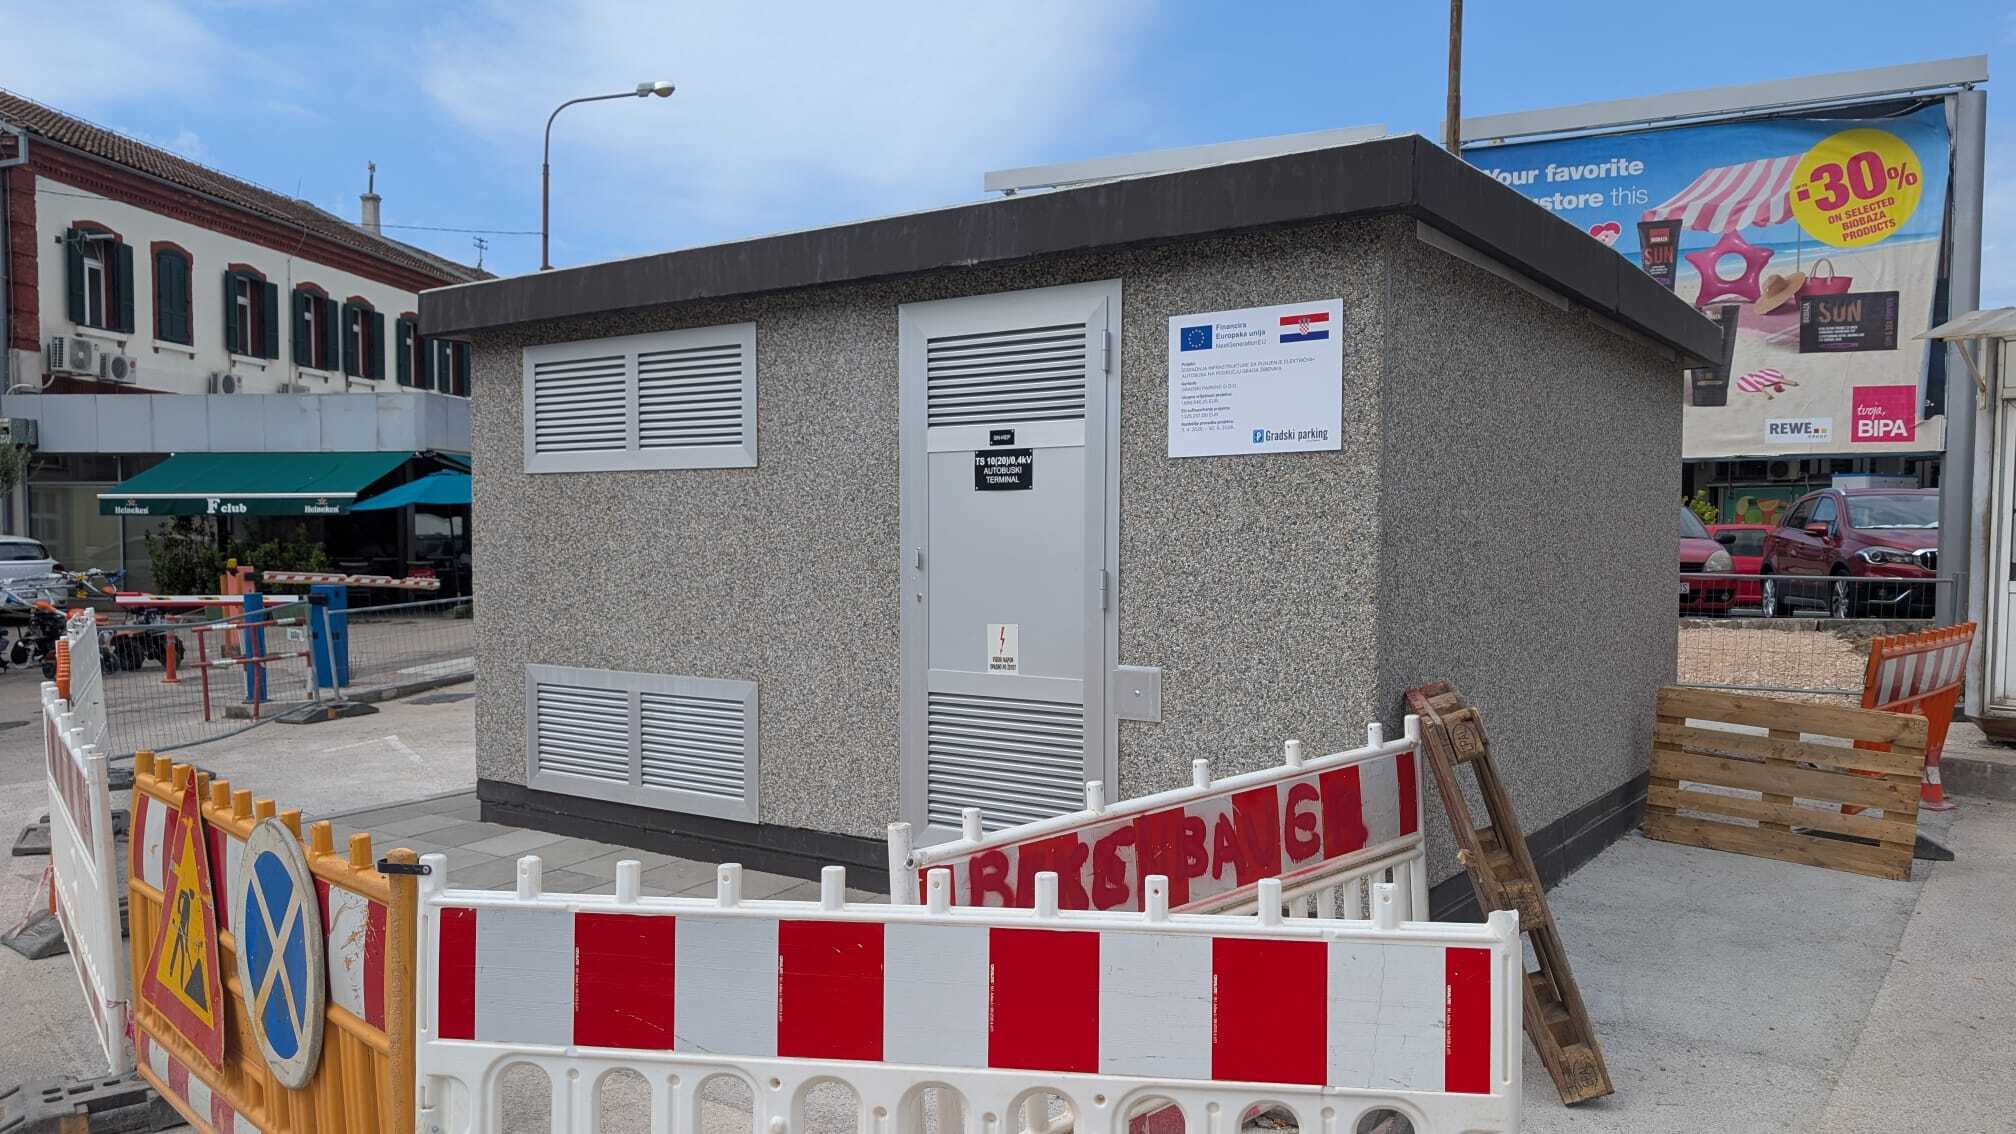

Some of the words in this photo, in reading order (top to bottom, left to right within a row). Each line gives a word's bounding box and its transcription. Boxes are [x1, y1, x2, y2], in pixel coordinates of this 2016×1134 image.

[1485, 167, 1539, 185] Your
[1545, 158, 1644, 182] favorite
[1797, 151, 1918, 211] -30%
[1533, 192, 1604, 211] store
[1610, 186, 1649, 206] this
[1828, 213, 1842, 225] ON
[1845, 196, 1895, 219] SELECTED
[1842, 210, 1887, 231] BIOBAZA
[1842, 218, 1897, 242] PRODUCTS
[1644, 247, 1674, 265] SUN
[1818, 300, 1862, 323] SUN
[1265, 428, 1296, 441] Gradski
[1298, 427, 1329, 442] parking
[1769, 422, 1813, 435] REWE
[1858, 419, 1909, 437] BIPA
[975, 457, 985, 466] TS
[983, 466, 1023, 475] AUTOBUSKI
[986, 475, 1021, 484] TERMINAL
[115, 506, 149, 514] Heineken
[206, 497, 220, 514] F
[220, 502, 247, 513] club
[304, 505, 340, 513] Heineken
